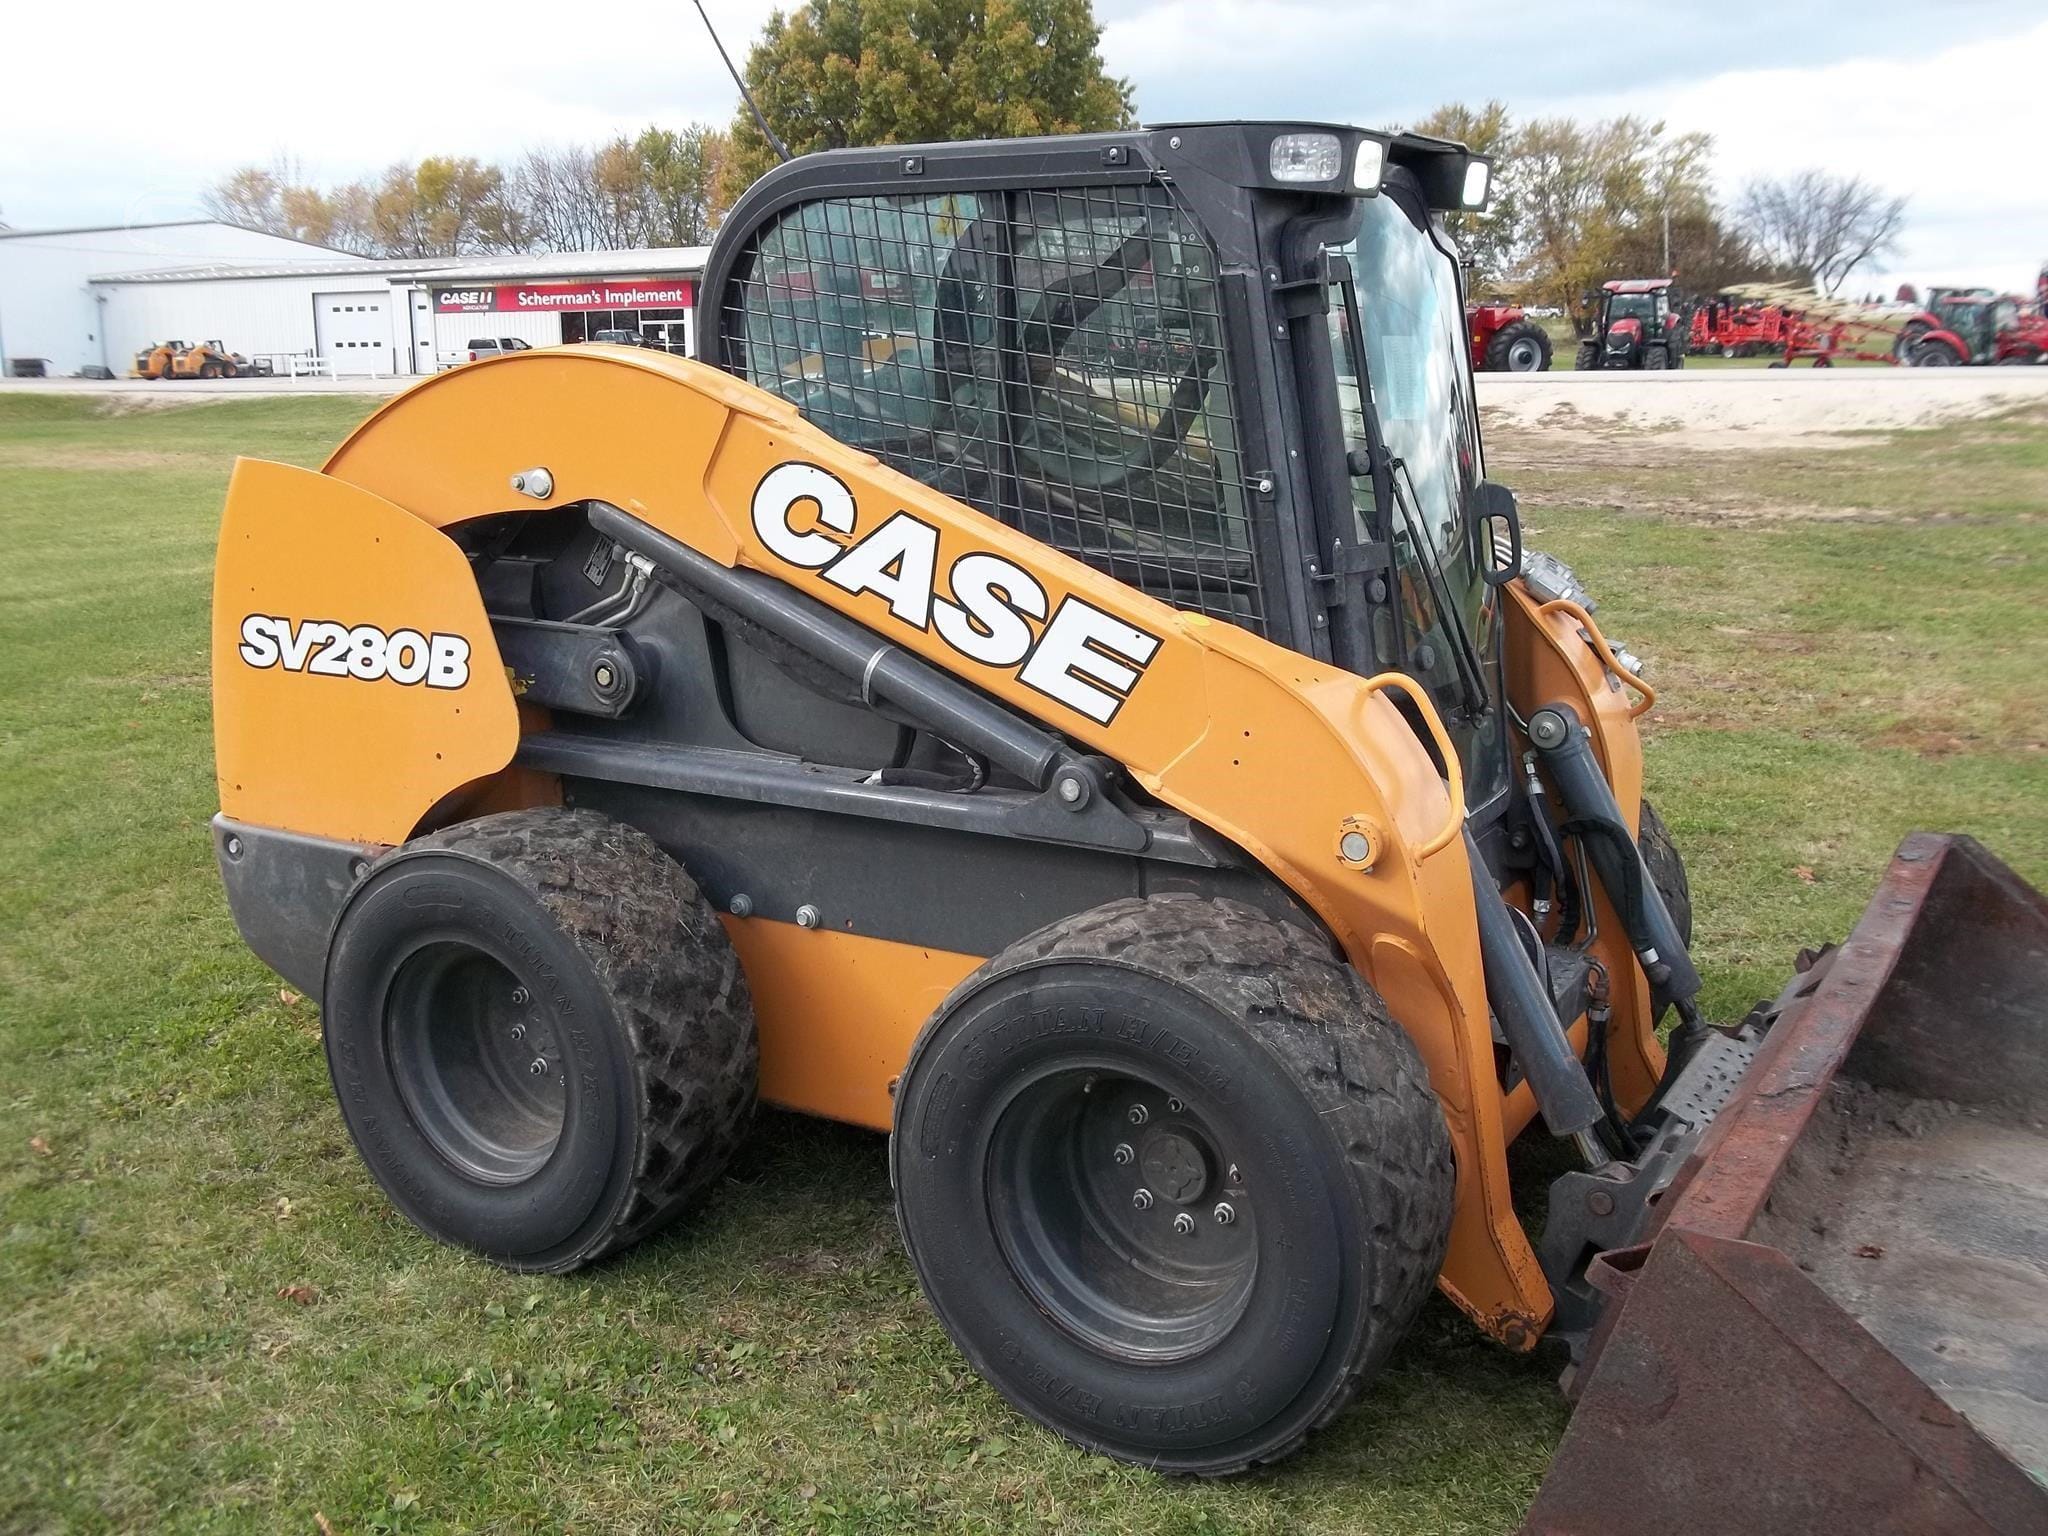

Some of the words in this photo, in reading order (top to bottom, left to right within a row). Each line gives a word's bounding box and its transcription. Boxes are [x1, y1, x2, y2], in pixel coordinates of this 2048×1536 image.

[440, 292, 479, 305] CASE
[518, 290, 601, 306] Scherrman's
[605, 288, 682, 307] Implement
[751, 461, 1165, 728] CASE
[239, 613, 471, 690] SV280B
[504, 920, 576, 1015] TITAN
[988, 1006, 1107, 1056] TITAN
